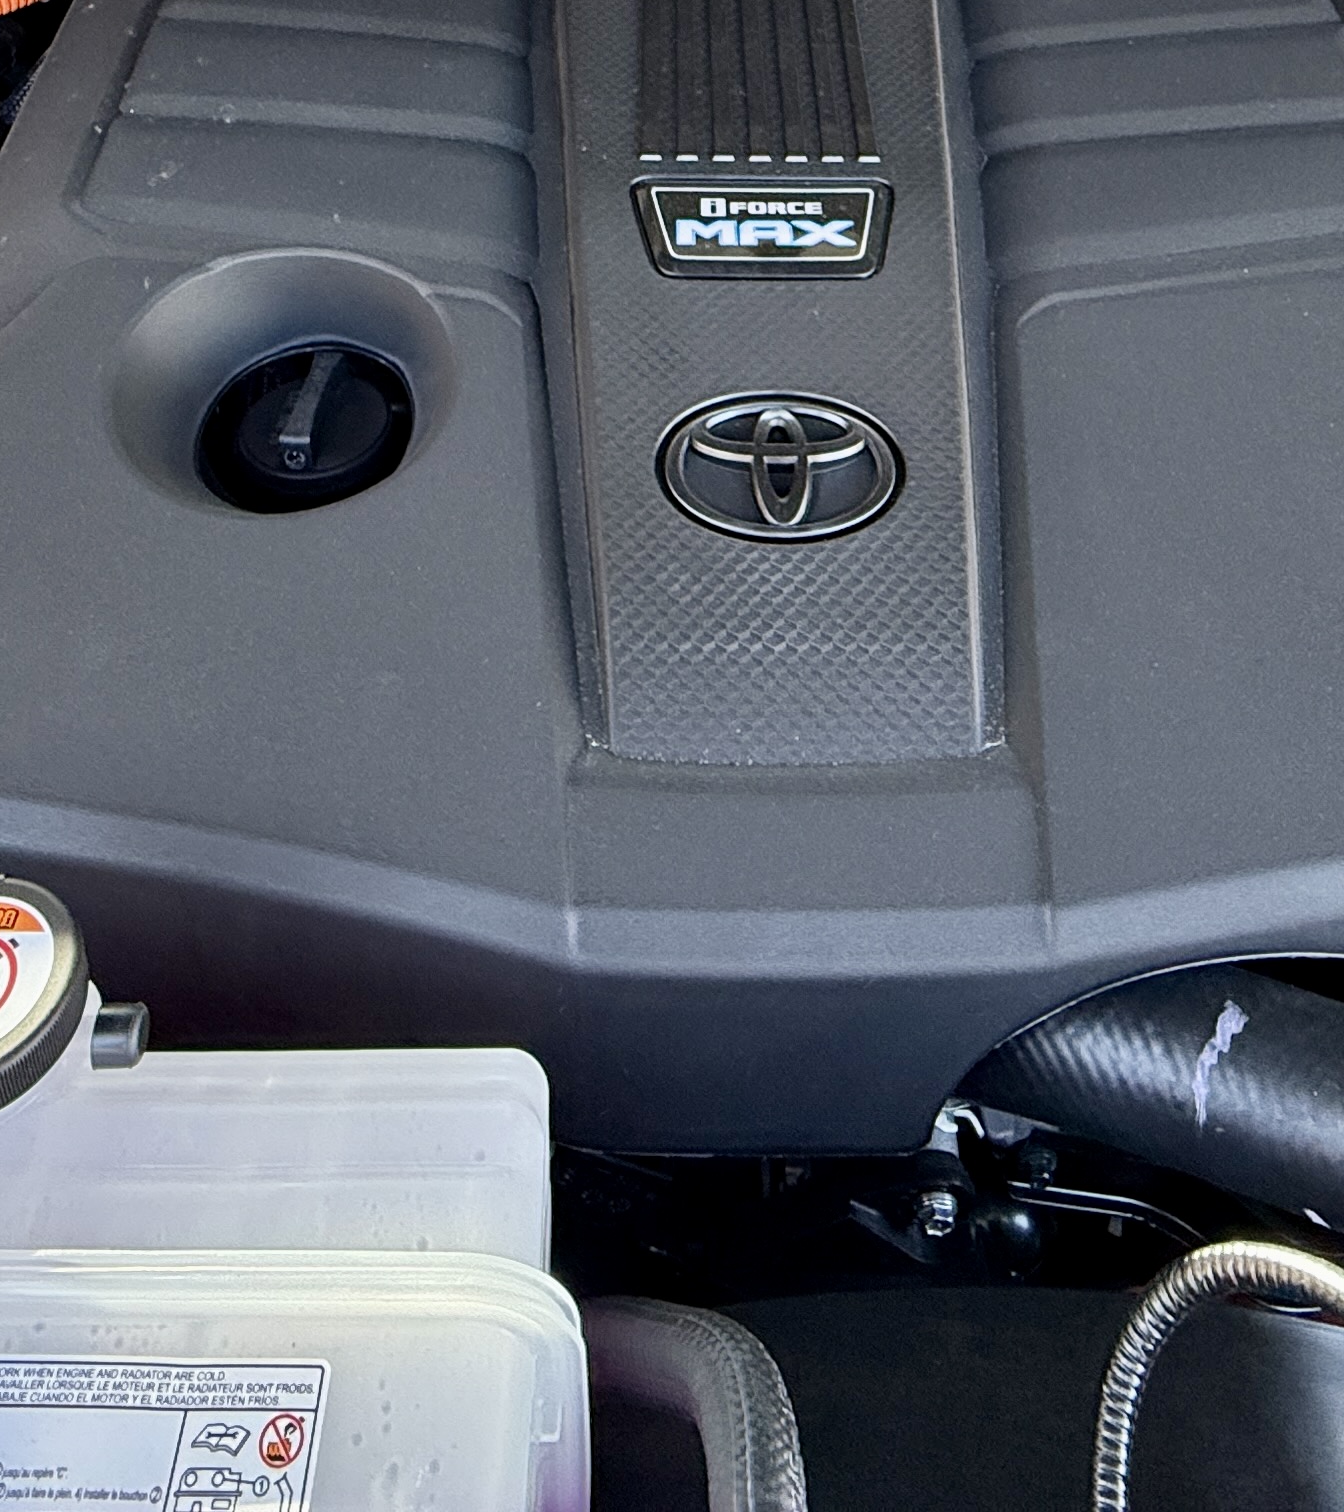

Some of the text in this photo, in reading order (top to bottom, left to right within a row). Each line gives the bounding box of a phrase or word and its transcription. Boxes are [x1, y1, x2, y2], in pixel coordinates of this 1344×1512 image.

[730, 201, 823, 216] FORCE
[675, 219, 857, 248] MAX
[23, 1367, 55, 1378] WHEN
[56, 1368, 96, 1379] ENGINE
[97, 1368, 119, 1379] AND
[120, 1369, 172, 1381] RADIATOR
[173, 1371, 194, 1381] ARE
[97, 1381, 110, 1392] LE
[112, 1381, 156, 1392] MOTEUR
[157, 1383, 171, 1393] ET
[172, 1383, 185, 1393] LE
[190, 1383, 243, 1394] RADIATEUR
[246, 1383, 273, 1394] SONT
[30, 1392, 74, 1403] CUANDO
[77, 1393, 88, 1403] EL
[91, 1393, 129, 1404] MOTOR
[140, 1394, 152, 1405] EL
[155, 1394, 208, 1405] RADIADOR
